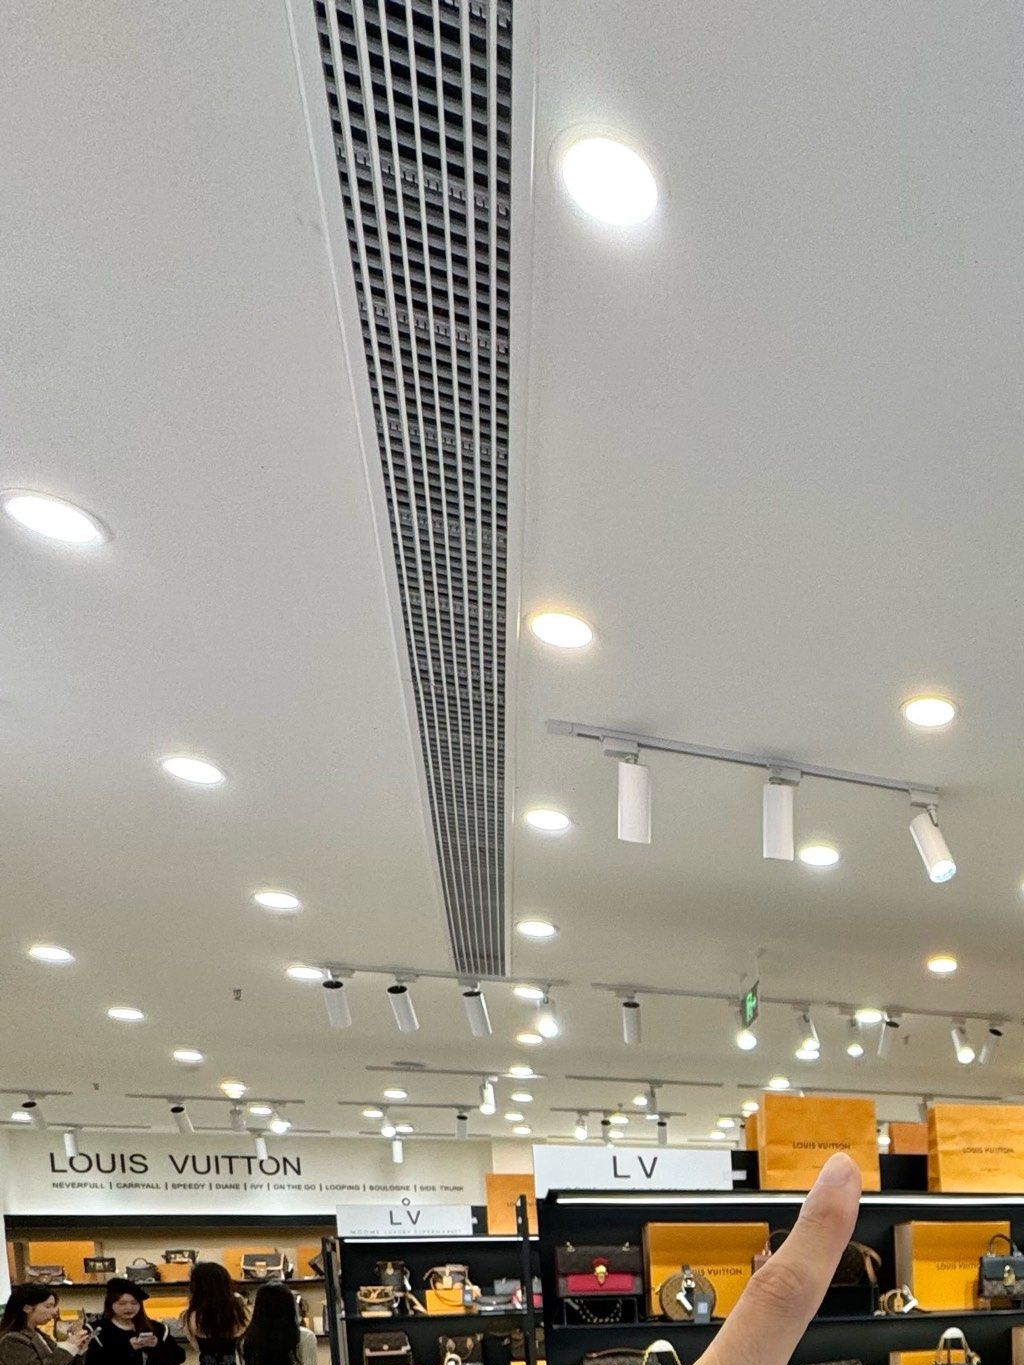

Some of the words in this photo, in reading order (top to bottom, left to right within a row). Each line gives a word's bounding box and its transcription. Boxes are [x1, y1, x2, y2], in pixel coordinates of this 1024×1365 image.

[792, 1141, 816, 1150] LOUIS
[50, 1152, 149, 1174] LOUIS
[168, 1154, 302, 1176] VUITTON
[52, 1182, 105, 1190] NEVERFULL
[116, 1182, 161, 1190] CARRYALL
[171, 1183, 205, 1191] SPEEDY
[215, 1183, 241, 1191] DIANE
[325, 1184, 360, 1192] LOOPING
[369, 1184, 411, 1192] BOULOGNE
[707, 1268, 743, 1276] VUITTON
